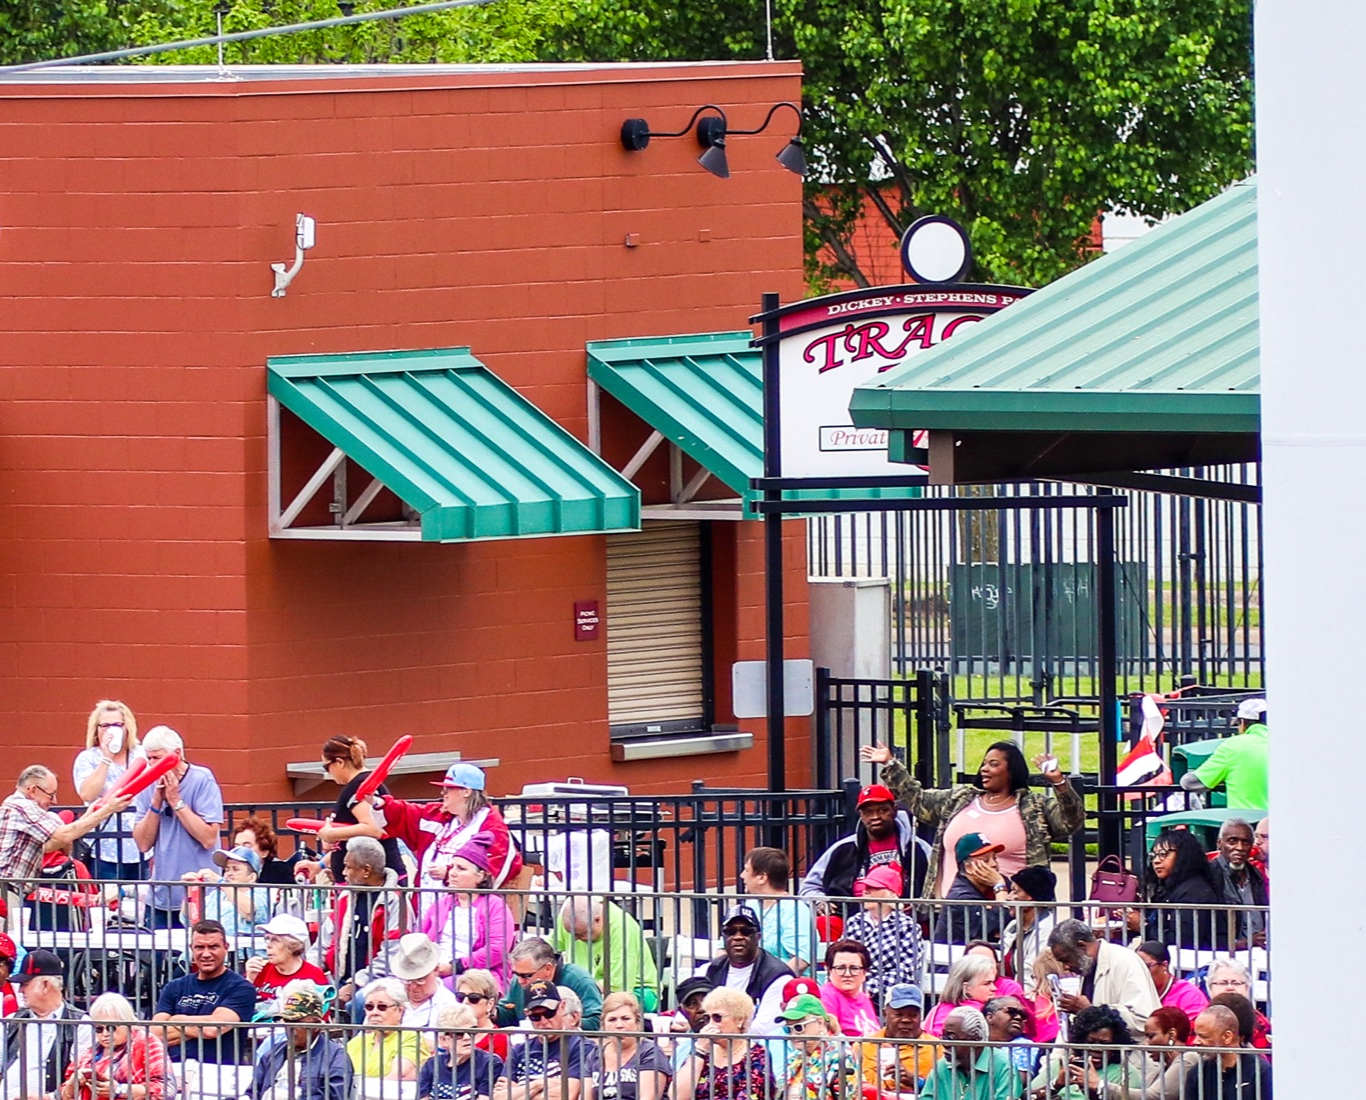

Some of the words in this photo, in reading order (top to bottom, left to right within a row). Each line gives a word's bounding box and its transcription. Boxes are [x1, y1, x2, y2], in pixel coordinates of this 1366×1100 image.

[827, 296, 896, 316] DICKEY
[903, 293, 997, 305] STEPHENS
[830, 430, 887, 447] Privat
